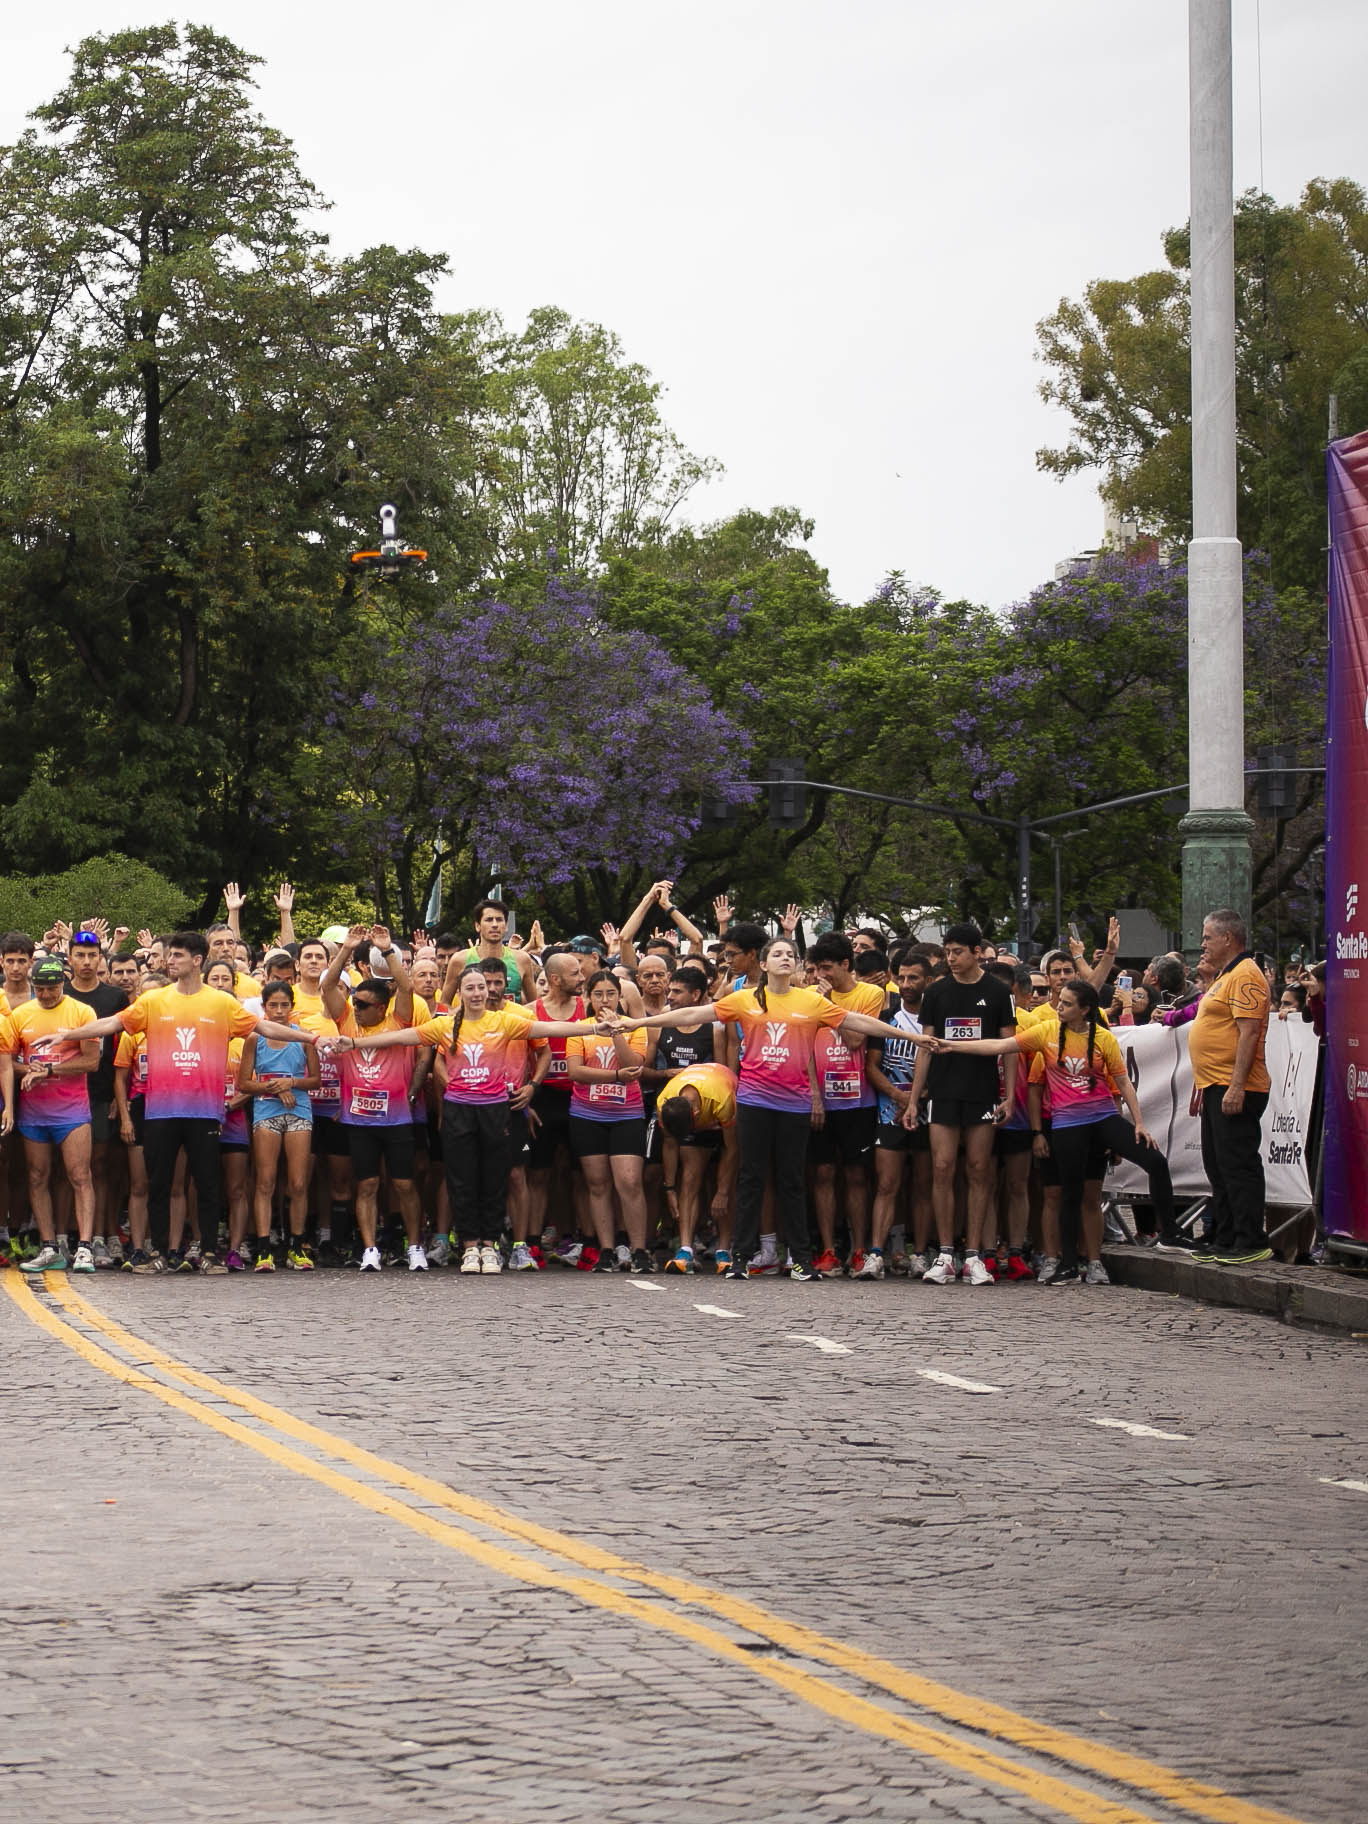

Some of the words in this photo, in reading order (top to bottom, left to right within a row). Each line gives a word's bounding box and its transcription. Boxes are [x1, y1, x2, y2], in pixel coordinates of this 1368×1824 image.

[952, 1027, 974, 1038] 263
[172, 1051, 201, 1062] COPA
[761, 1046, 790, 1056] COPA
[826, 1046, 849, 1056] COP
[461, 1067, 490, 1078] COPA
[595, 1084, 623, 1096] 5643
[357, 1097, 384, 1110] 5805
